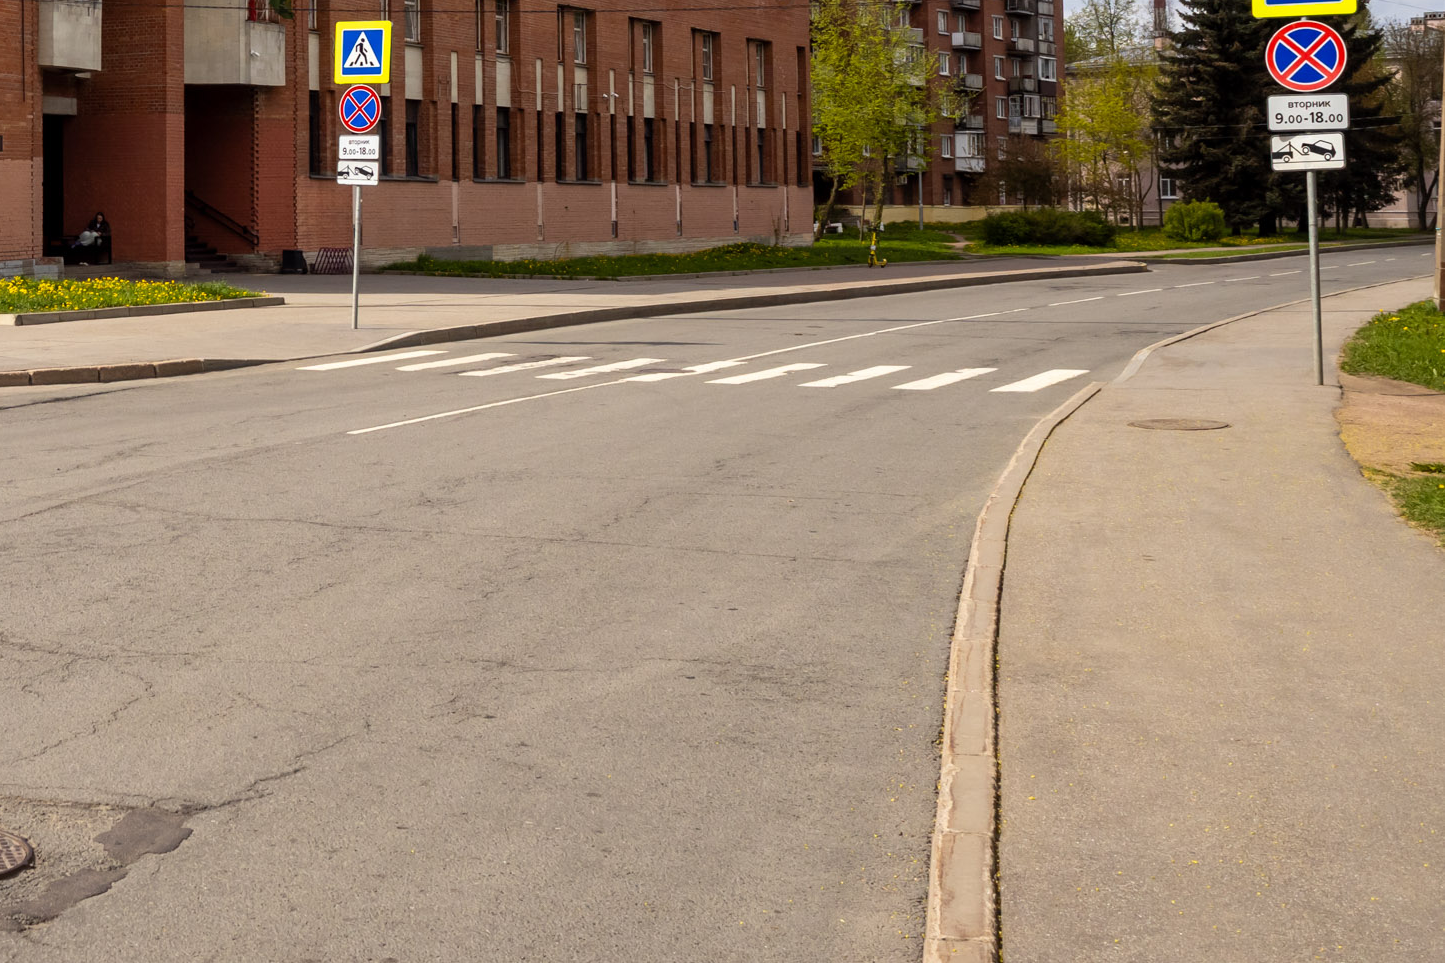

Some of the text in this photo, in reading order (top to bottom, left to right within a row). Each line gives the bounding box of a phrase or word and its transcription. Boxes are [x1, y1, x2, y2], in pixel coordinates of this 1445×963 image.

[1288, 100, 1331, 109] вторник
[1275, 111, 1343, 124] 9.00-18.00
[342, 147, 376, 156] 9.00-18.00
